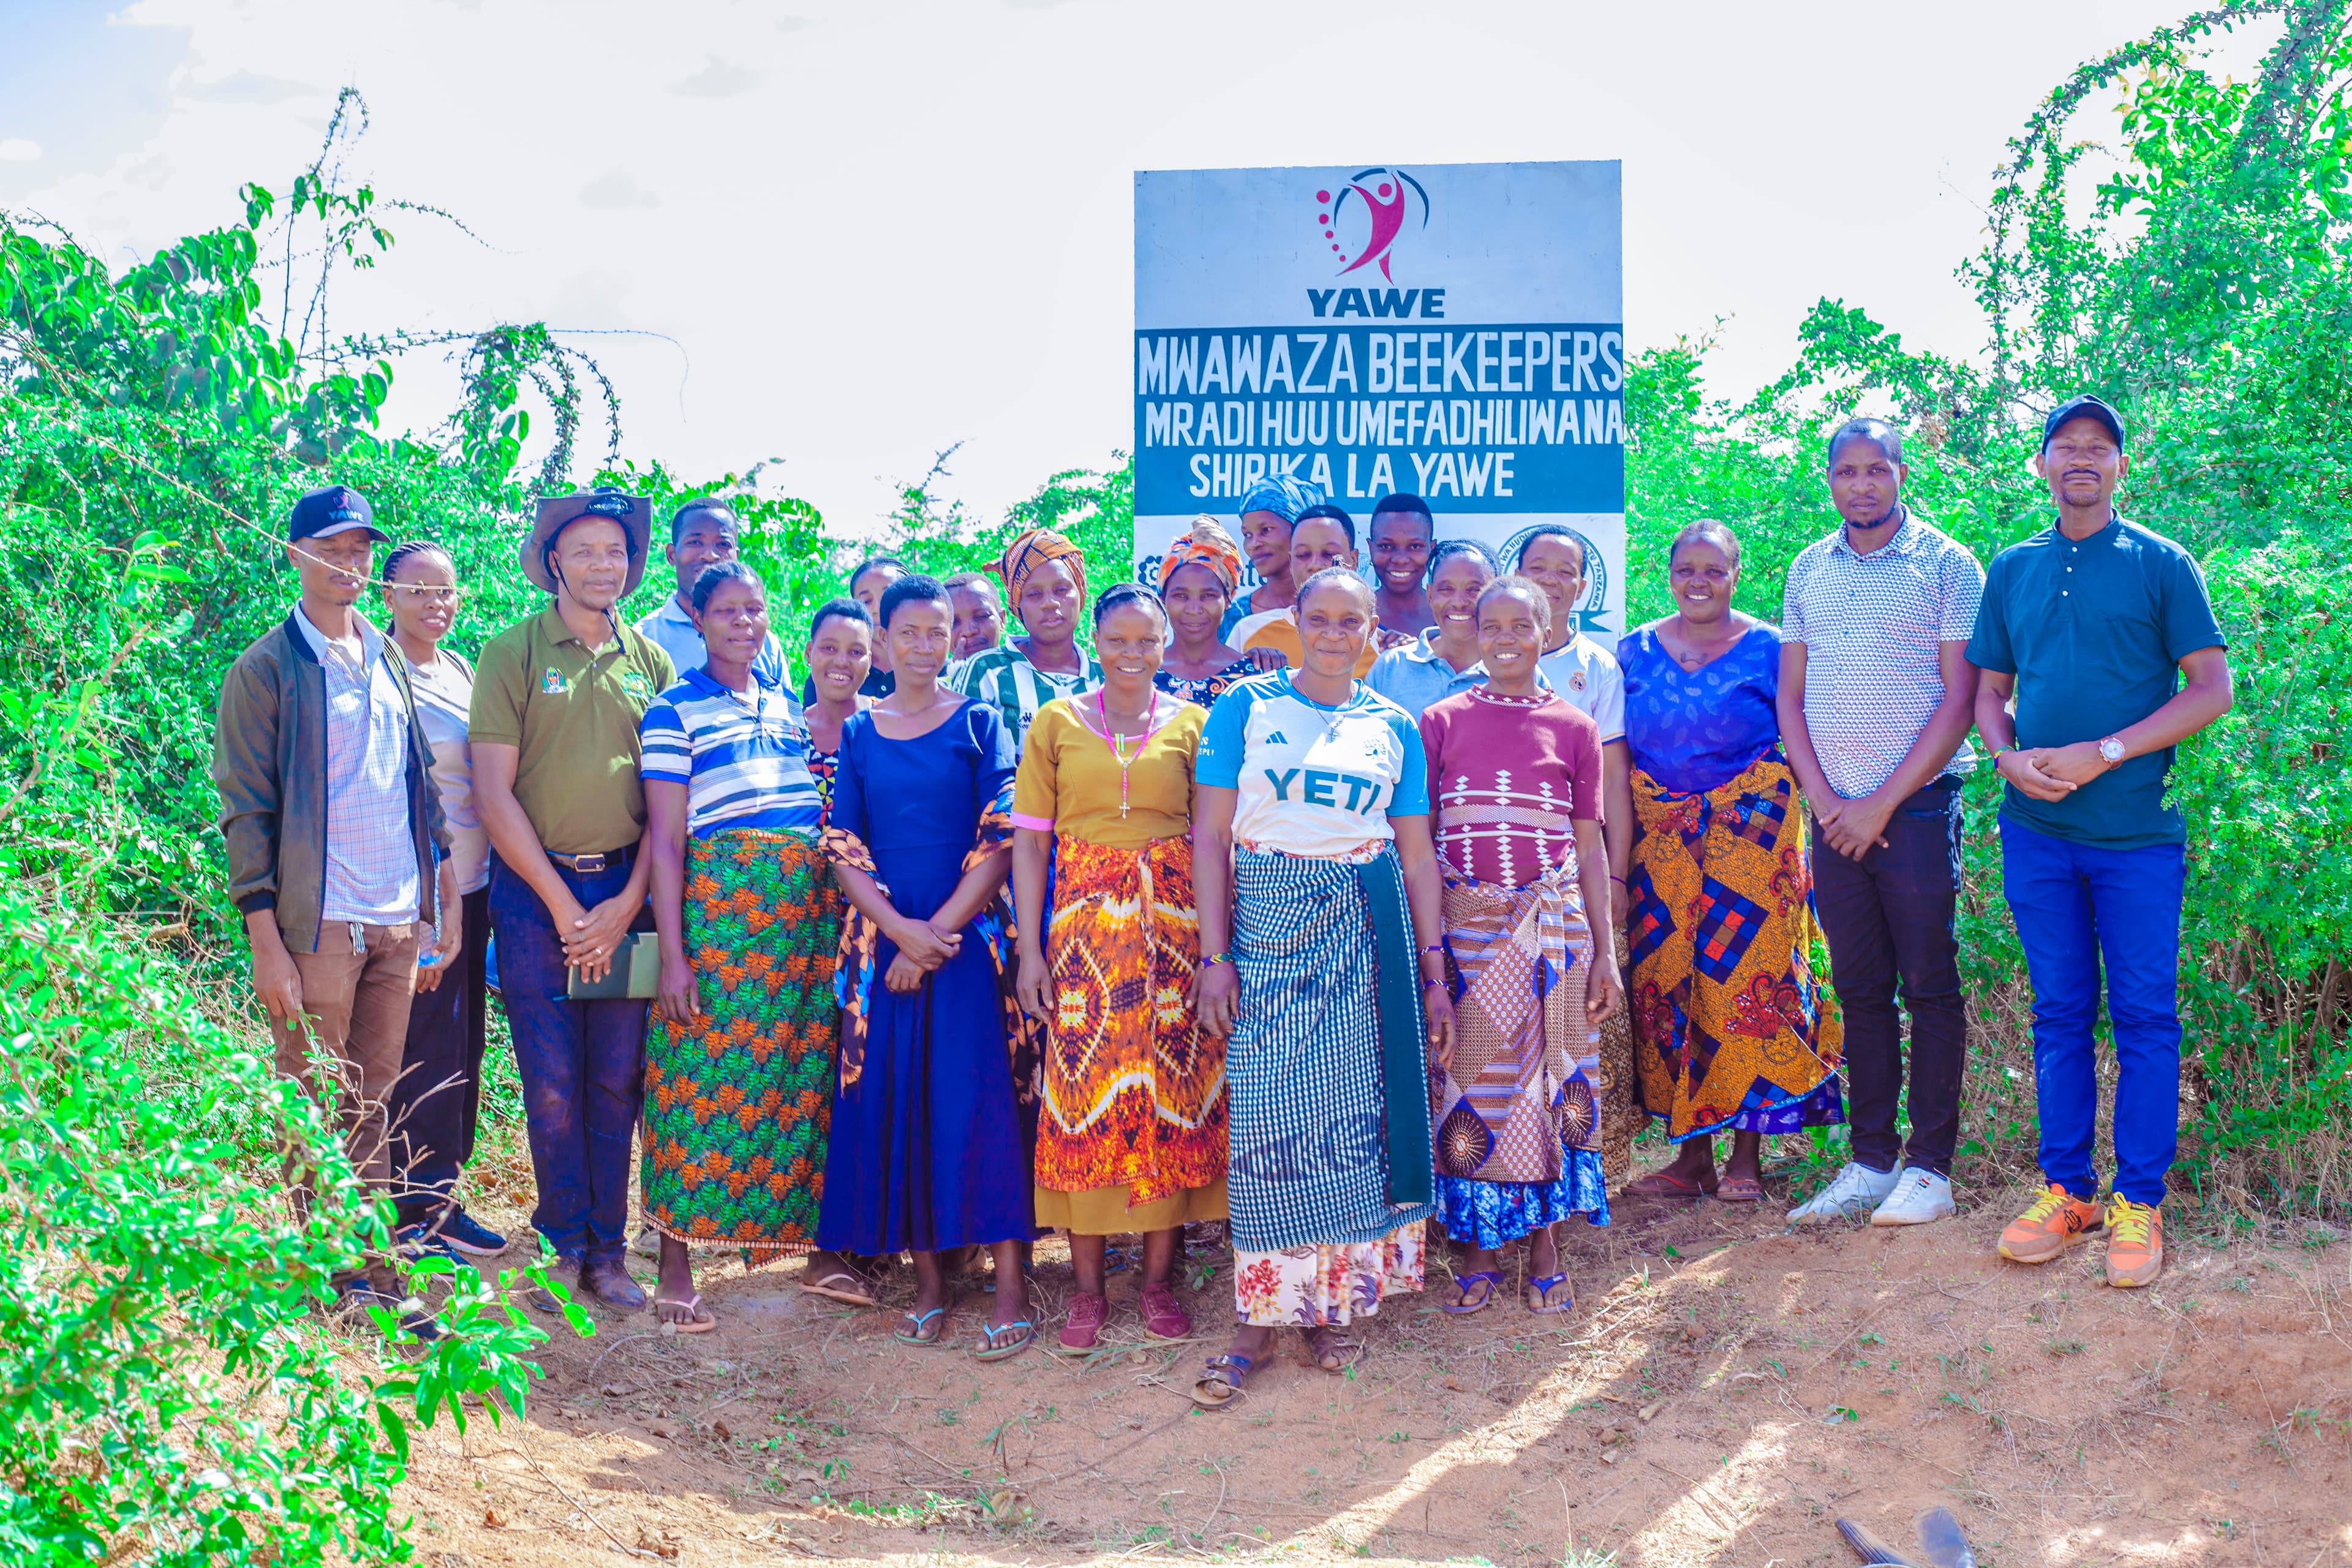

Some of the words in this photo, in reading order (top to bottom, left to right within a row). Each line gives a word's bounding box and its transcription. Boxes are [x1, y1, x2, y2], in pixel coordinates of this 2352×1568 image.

[1306, 288, 1446, 318] YAWE
[1138, 333, 1358, 395] MWAWAZA
[1368, 331, 1623, 393] BEEKEEPERS
[1145, 401, 1255, 447] MRADI
[1261, 400, 1329, 447] HUU
[1346, 453, 1396, 498] LA
[1409, 452, 1515, 497] YAWE
[328, 509, 364, 521] YAWE
[1591, 562, 1603, 608] TANZANIA
